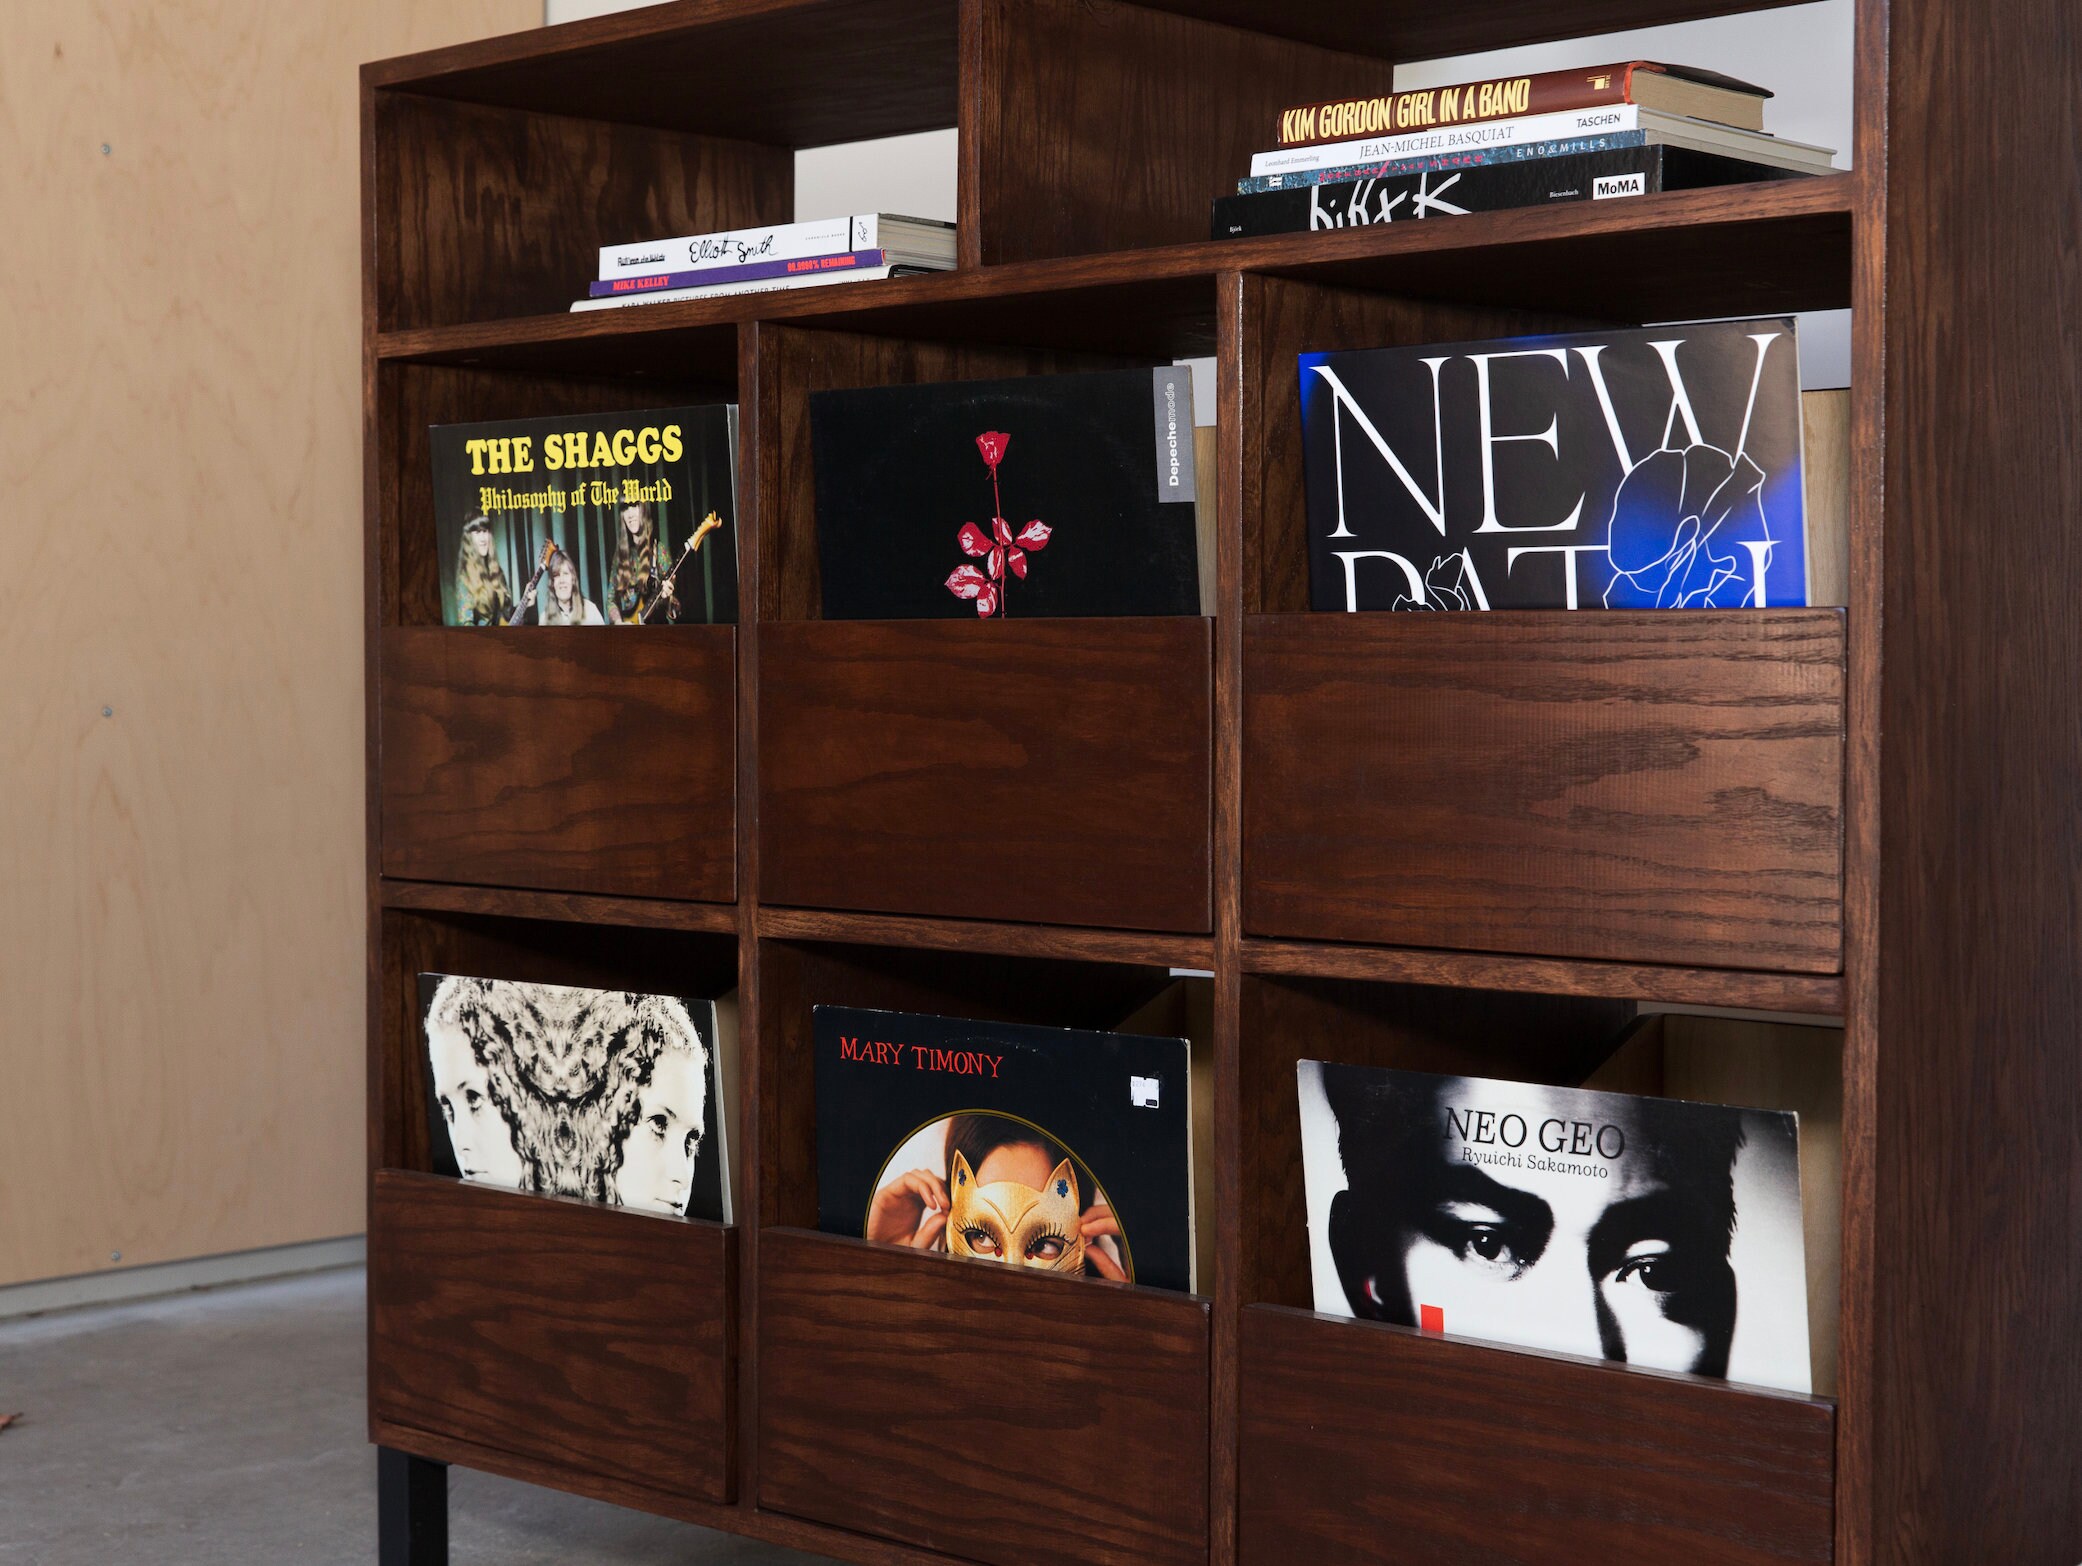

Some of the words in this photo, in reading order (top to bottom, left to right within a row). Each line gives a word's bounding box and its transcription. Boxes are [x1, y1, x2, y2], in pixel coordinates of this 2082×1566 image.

[1282, 106, 1317, 143] KIM
[1319, 96, 1394, 138] GORDON
[1396, 91, 1436, 128] GIRL
[1439, 87, 1461, 122] IN
[1462, 85, 1477, 120] A
[1478, 78, 1532, 117] BAND
[1576, 113, 1621, 128] TASCHEN
[1359, 132, 1444, 159] JEAN-MICHEL
[1447, 126, 1515, 147] BASQUIAT
[1264, 157, 1290, 168] Leonhard
[1290, 154, 1320, 166] Emmerling
[1597, 179, 1640, 196] MoMA
[737, 234, 779, 264] Smith
[612, 279, 635, 291] MIKE
[637, 275, 670, 288] KELLEY
[465, 436, 534, 475] THE
[543, 424, 683, 470] SHAGGS
[1308, 333, 1782, 538] NEW
[480, 484, 567, 515] Philosophy
[571, 482, 587, 506] of
[590, 481, 620, 510] The
[622, 478, 673, 504] World
[839, 1036, 905, 1065] MARY
[910, 1046, 1004, 1078] TIMONY
[1444, 1106, 1528, 1148] NEO
[1538, 1118, 1626, 1159] GEO
[1462, 1146, 1522, 1169] Ryuichi
[1527, 1153, 1608, 1179] Sakamoto
